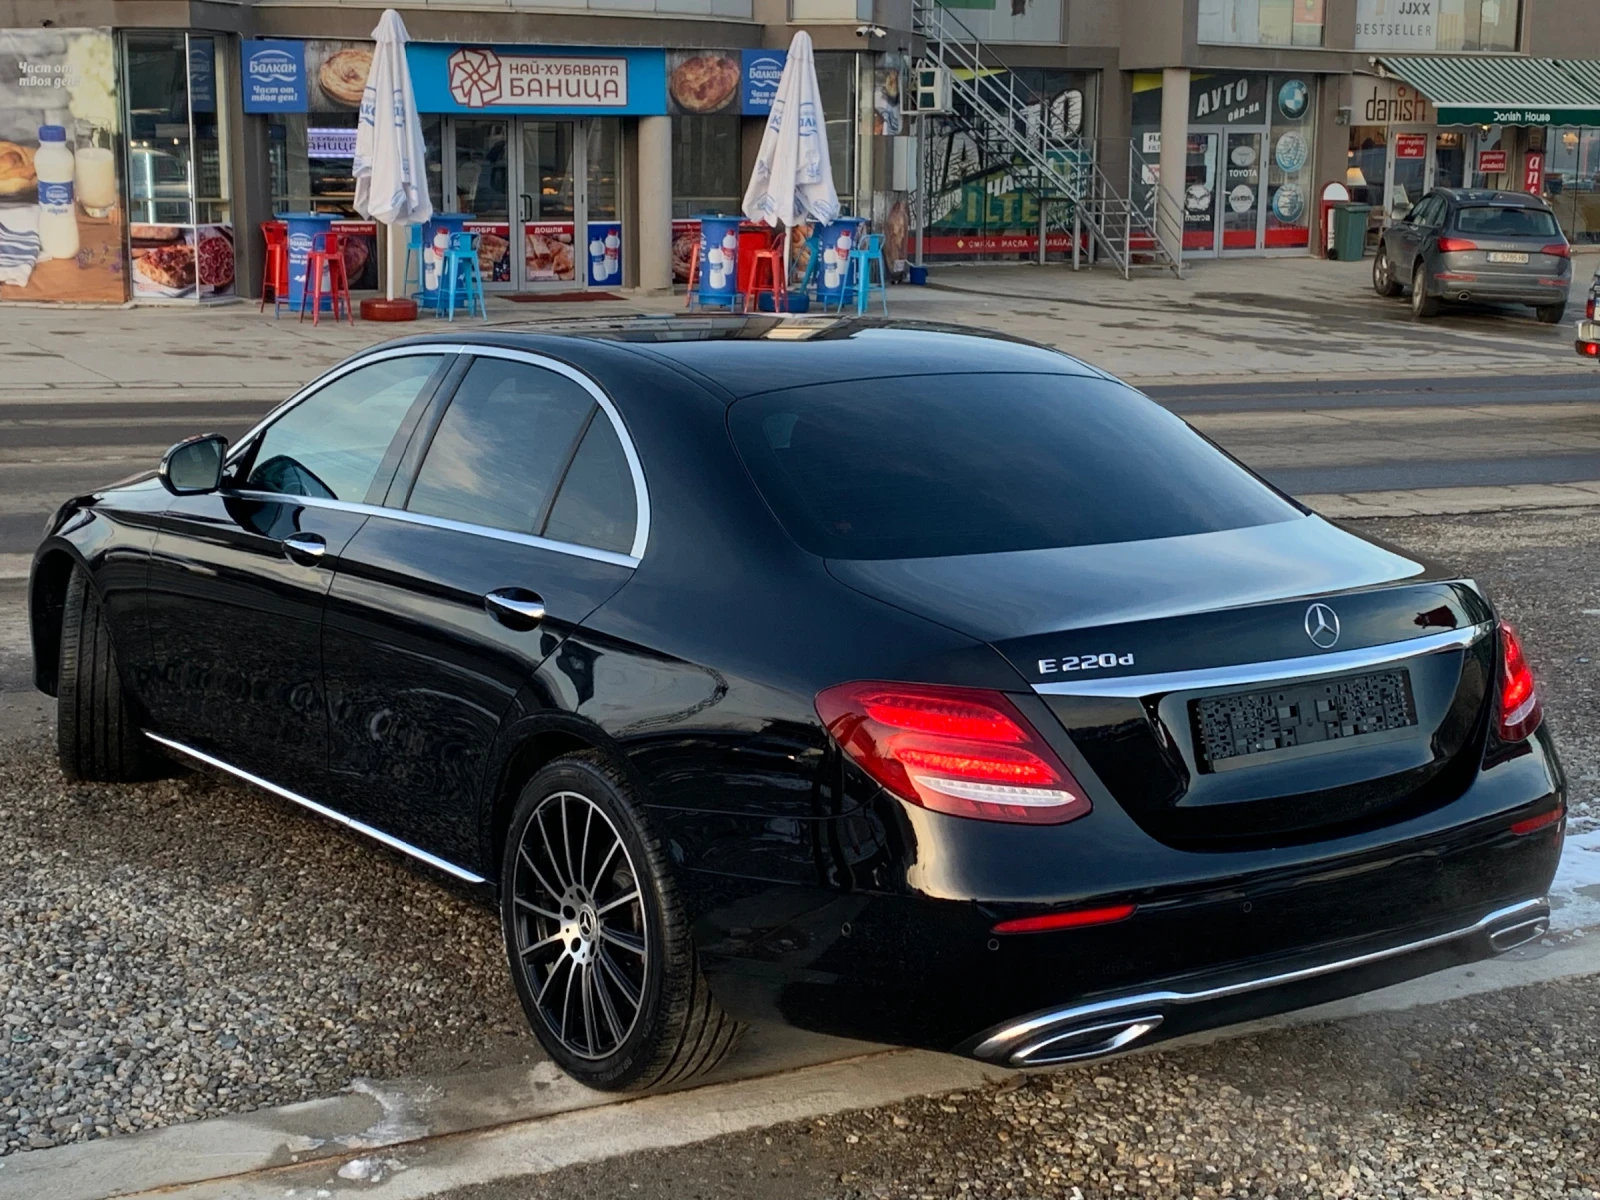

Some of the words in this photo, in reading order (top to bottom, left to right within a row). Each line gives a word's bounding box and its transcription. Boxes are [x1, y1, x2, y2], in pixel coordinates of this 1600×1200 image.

[1398, 1, 1430, 16] JJXX
[1355, 23, 1432, 36] BESTSELLER
[18, 61, 51, 73] Част
[249, 61, 297, 73] Балкан
[509, 60, 619, 76] НАЙ-ХУБАВАТА
[18, 76, 51, 87] твоя
[253, 85, 278, 94] Част
[509, 78, 619, 102] БАНИЦА
[251, 93, 276, 102] твоя
[278, 93, 298, 103] ден!
[1196, 77, 1249, 118] АУТО
[1365, 86, 1425, 121] danish
[1493, 110, 1521, 122] Danish
[1524, 112, 1550, 123] House
[1229, 169, 1257, 177] TOYOTA
[534, 226, 563, 234] ДОШЛИ
[1038, 658, 1058, 674] E
[1063, 652, 1134, 672] 220d
